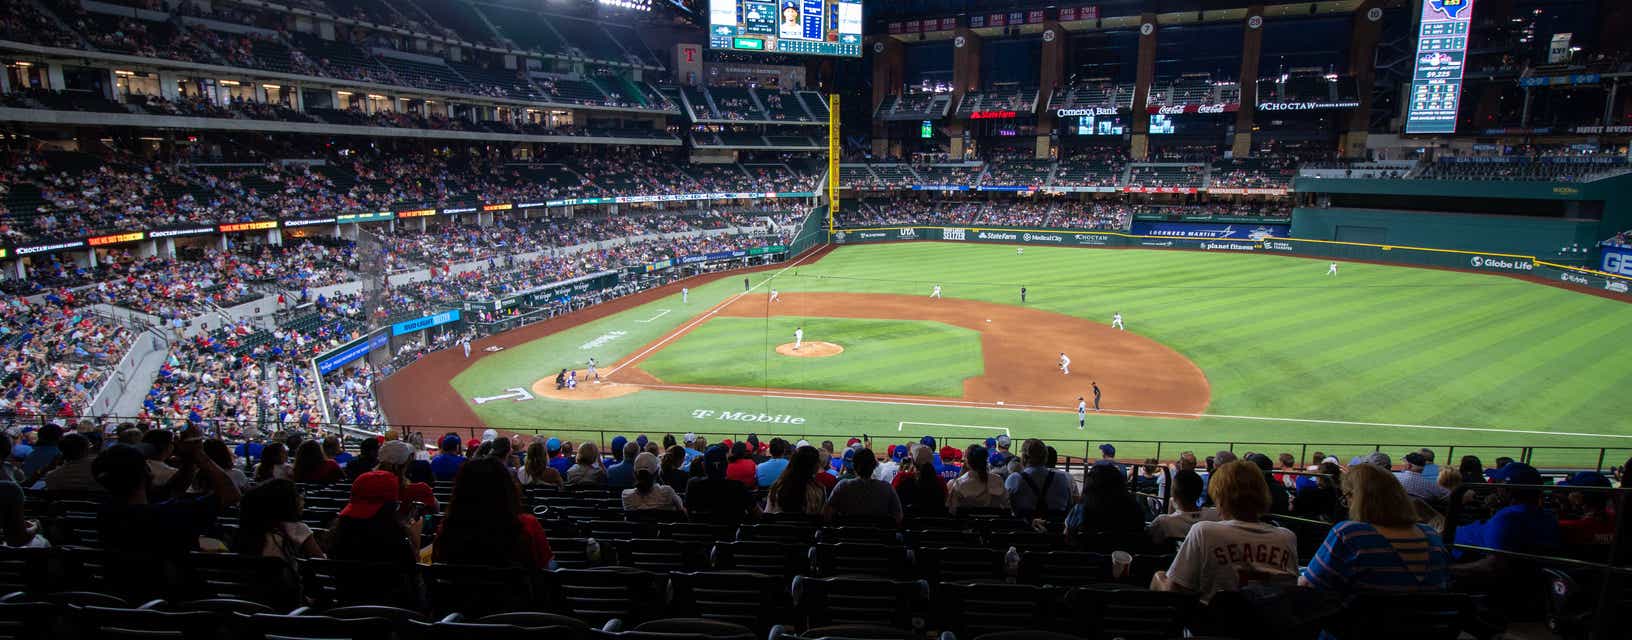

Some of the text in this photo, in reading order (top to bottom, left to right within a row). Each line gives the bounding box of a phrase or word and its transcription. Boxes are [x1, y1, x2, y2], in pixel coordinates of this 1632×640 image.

[683, 47, 697, 62] T
[1158, 105, 1184, 114] Coca-Cola
[1197, 104, 1224, 113] Coca-Cola
[1265, 102, 1316, 110] CHOCTAW
[1096, 107, 1118, 115] Bank
[900, 228, 915, 236] UTA
[943, 232, 966, 240] SELTZER
[1207, 242, 1230, 250] planet
[1484, 258, 1533, 270] Globe Life
[720, 410, 806, 425] Mobile
[1214, 543, 1289, 570] SEAGER
